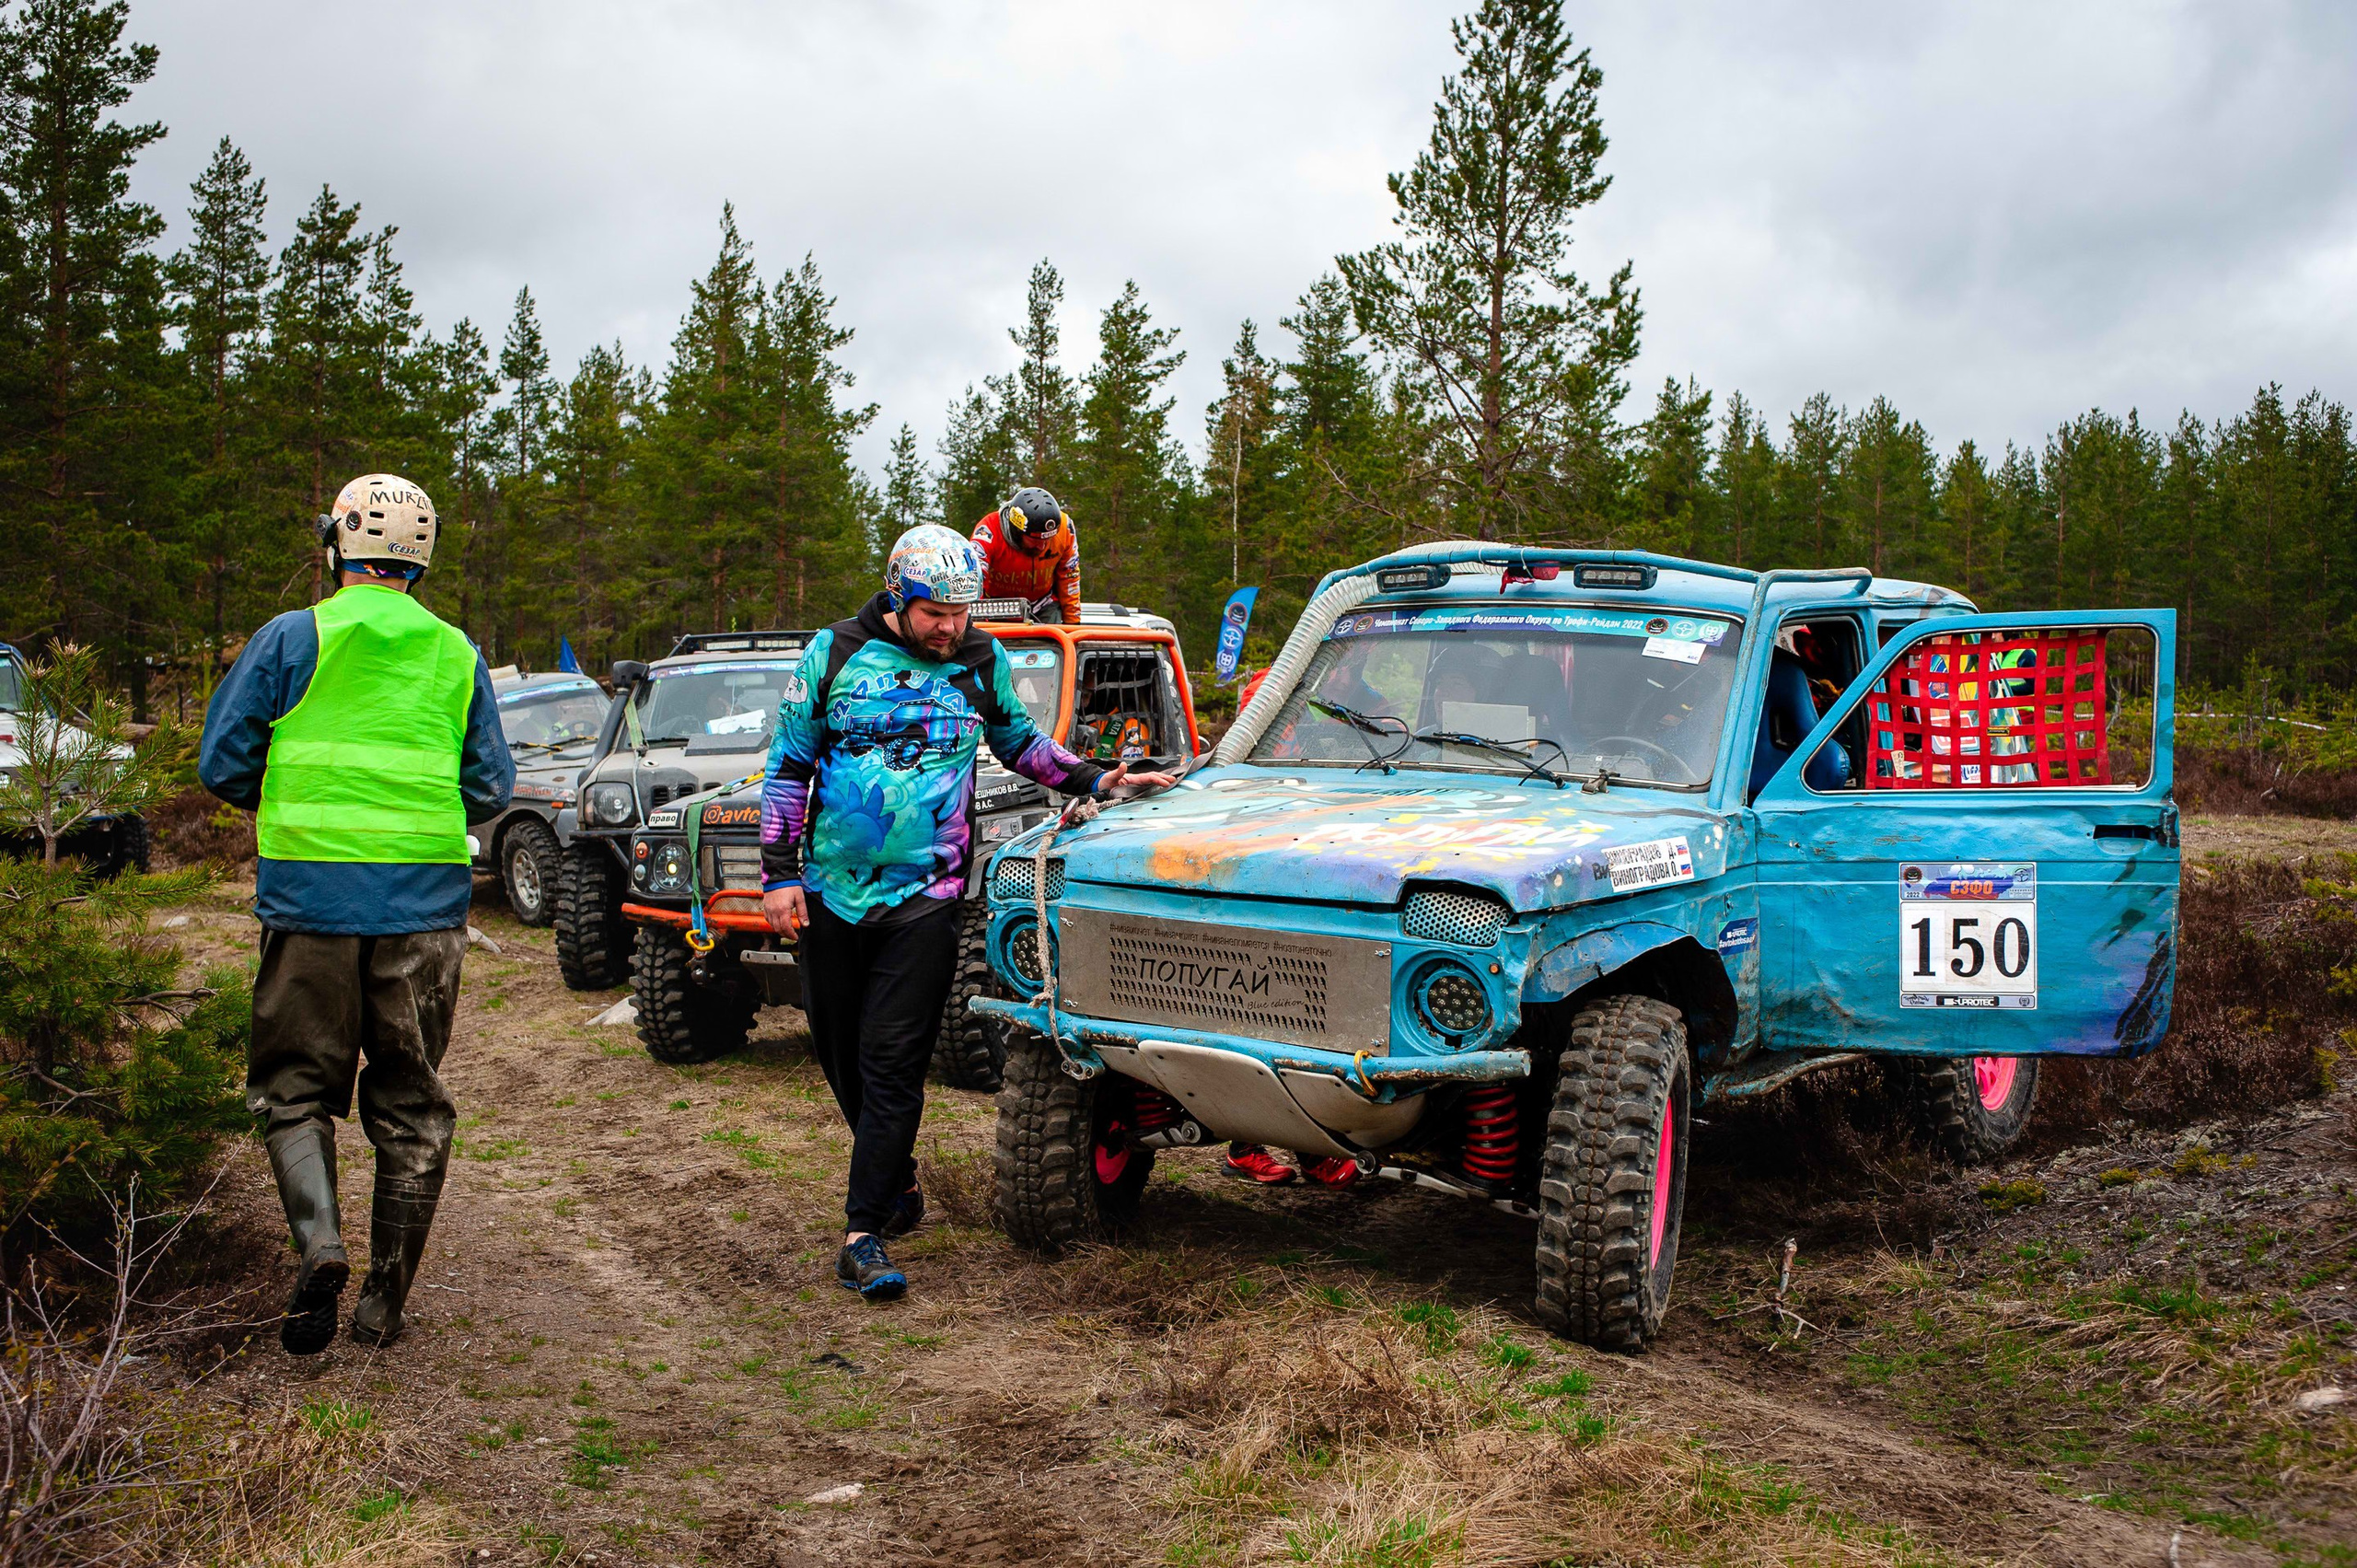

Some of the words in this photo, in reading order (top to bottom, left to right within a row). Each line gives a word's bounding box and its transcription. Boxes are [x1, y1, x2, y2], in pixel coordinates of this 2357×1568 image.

[1409, 615, 1471, 626] Северо-Западного
[1472, 614, 1525, 625] Федерального
[1525, 614, 1550, 625] Округа
[1552, 617, 1562, 625] по
[1563, 615, 1620, 629] Трофи-Рейдам
[1621, 619, 1643, 630] 2022
[650, 815, 676, 824] право
[1611, 862, 1670, 887] ВИНОГРАДОВА
[1202, 932, 1270, 950] #ниванеломается
[1911, 917, 2030, 978] 150
[1140, 958, 1269, 996] ПОПУГАЙ
[1247, 999, 1270, 1010] Blue
[1271, 998, 1306, 1009] edition
[1952, 997, 1995, 1006] SUPROTEC
